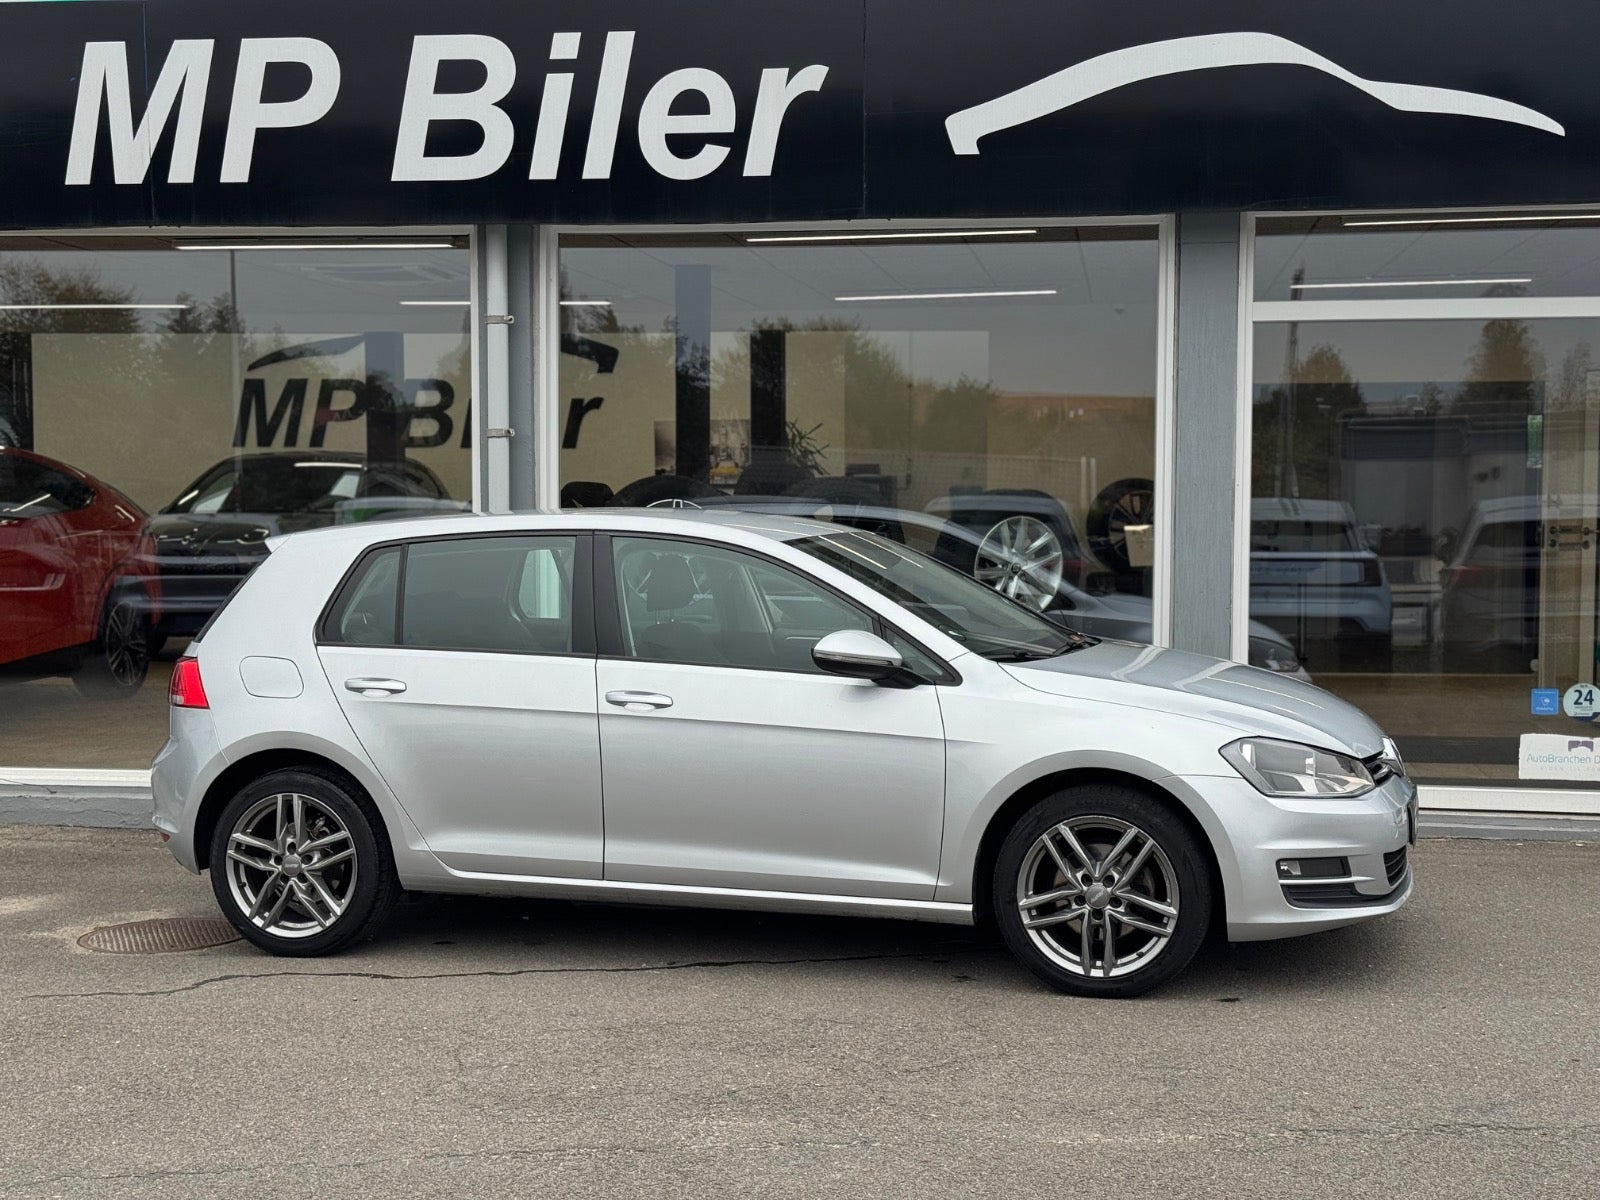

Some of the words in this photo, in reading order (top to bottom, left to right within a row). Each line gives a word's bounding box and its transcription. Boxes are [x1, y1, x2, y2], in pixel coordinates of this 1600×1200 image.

[65, 36, 341, 186] MP
[391, 30, 829, 182] Biler
[233, 378, 369, 448] MP
[1573, 689, 1594, 705] 24
[1526, 753, 1592, 764] AutoBranchen
